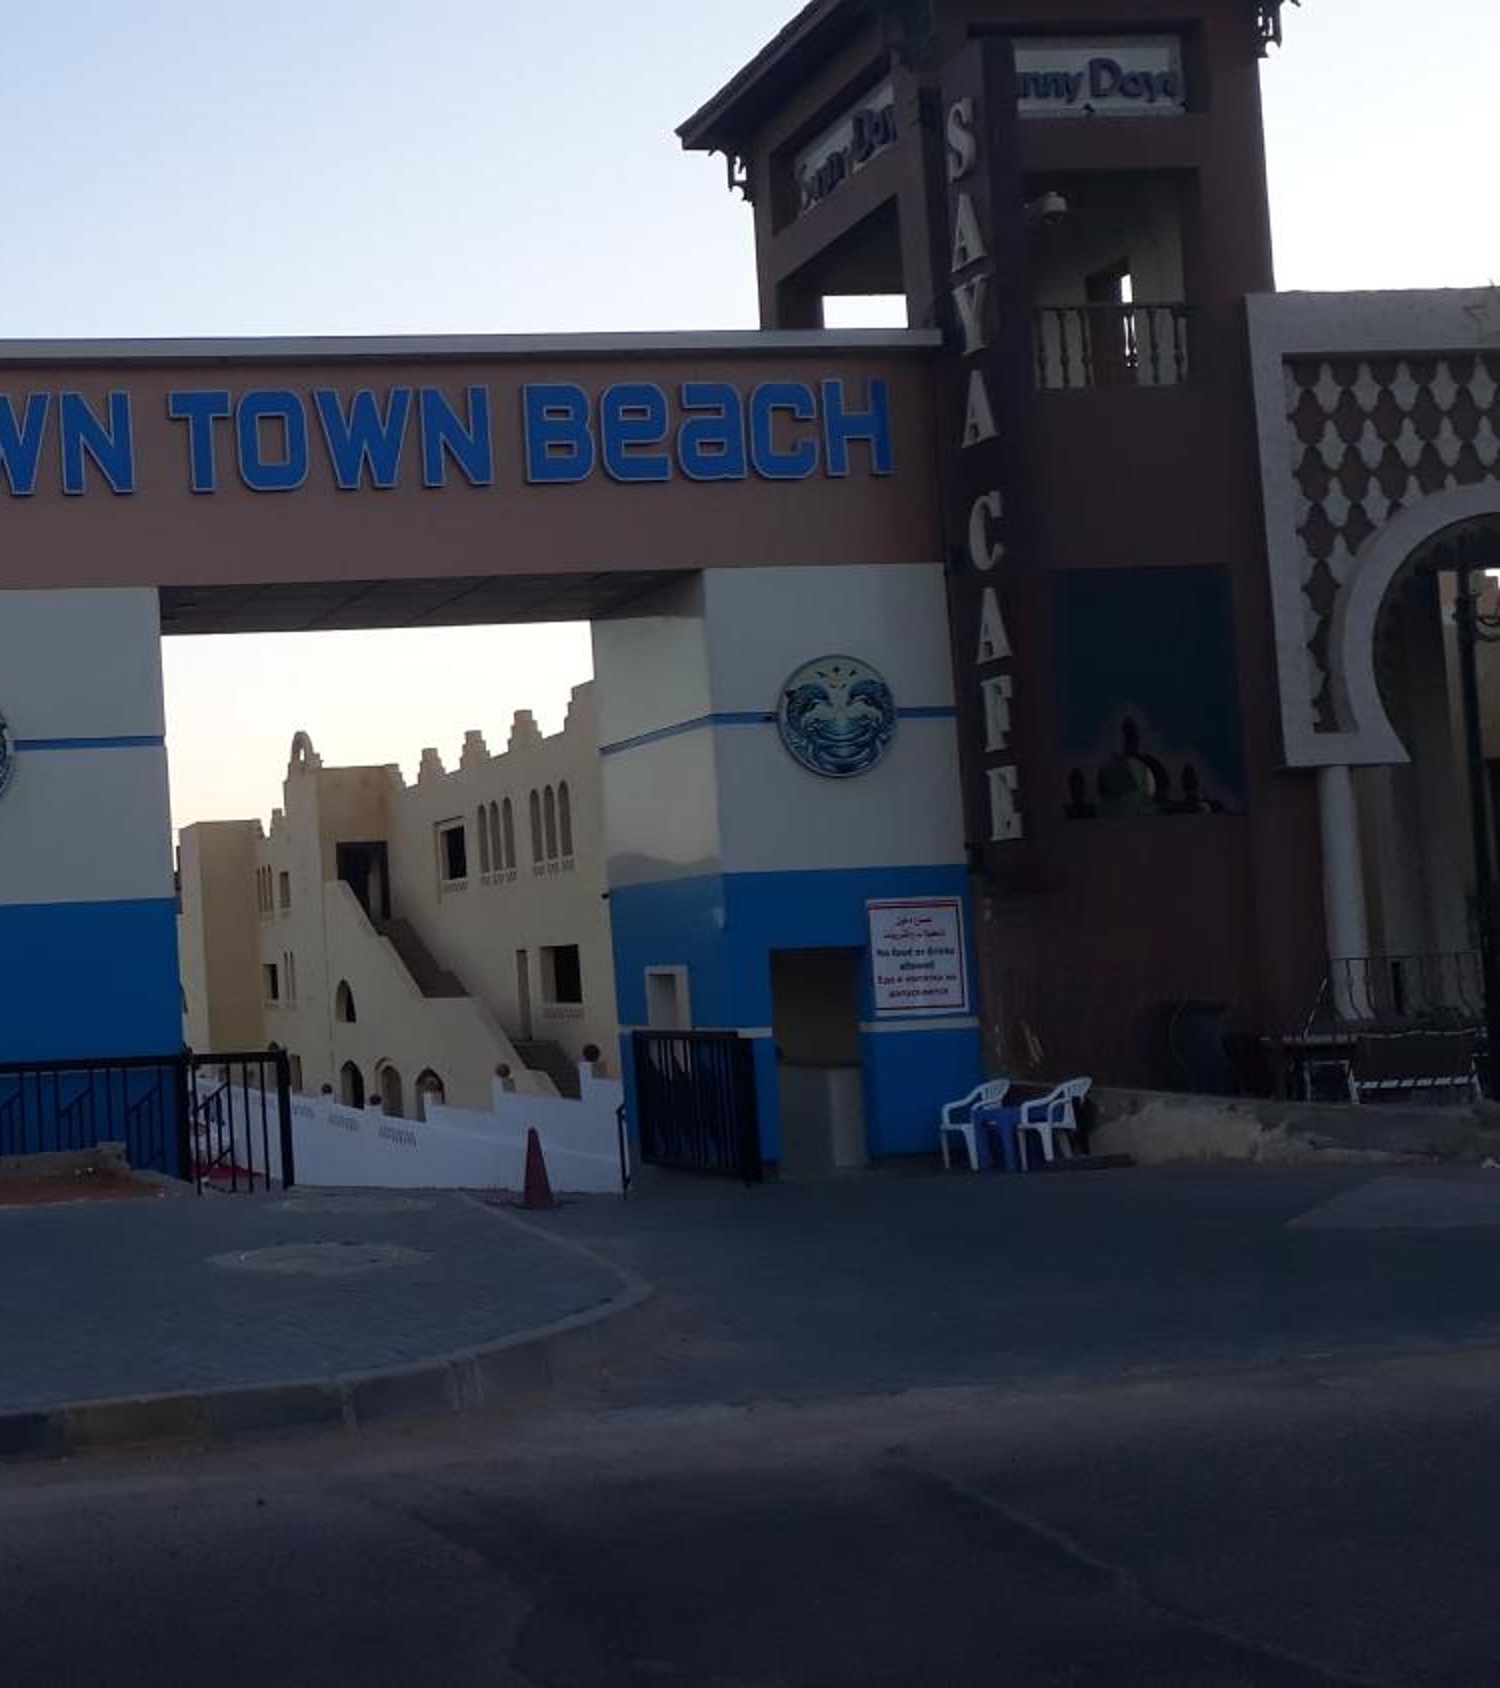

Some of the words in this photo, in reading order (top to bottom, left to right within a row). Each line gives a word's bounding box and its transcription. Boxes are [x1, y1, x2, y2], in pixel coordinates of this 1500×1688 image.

[167, 385, 494, 493] TOWN
[947, 97, 998, 449] SAYA
[968, 490, 1028, 842] CAFE
